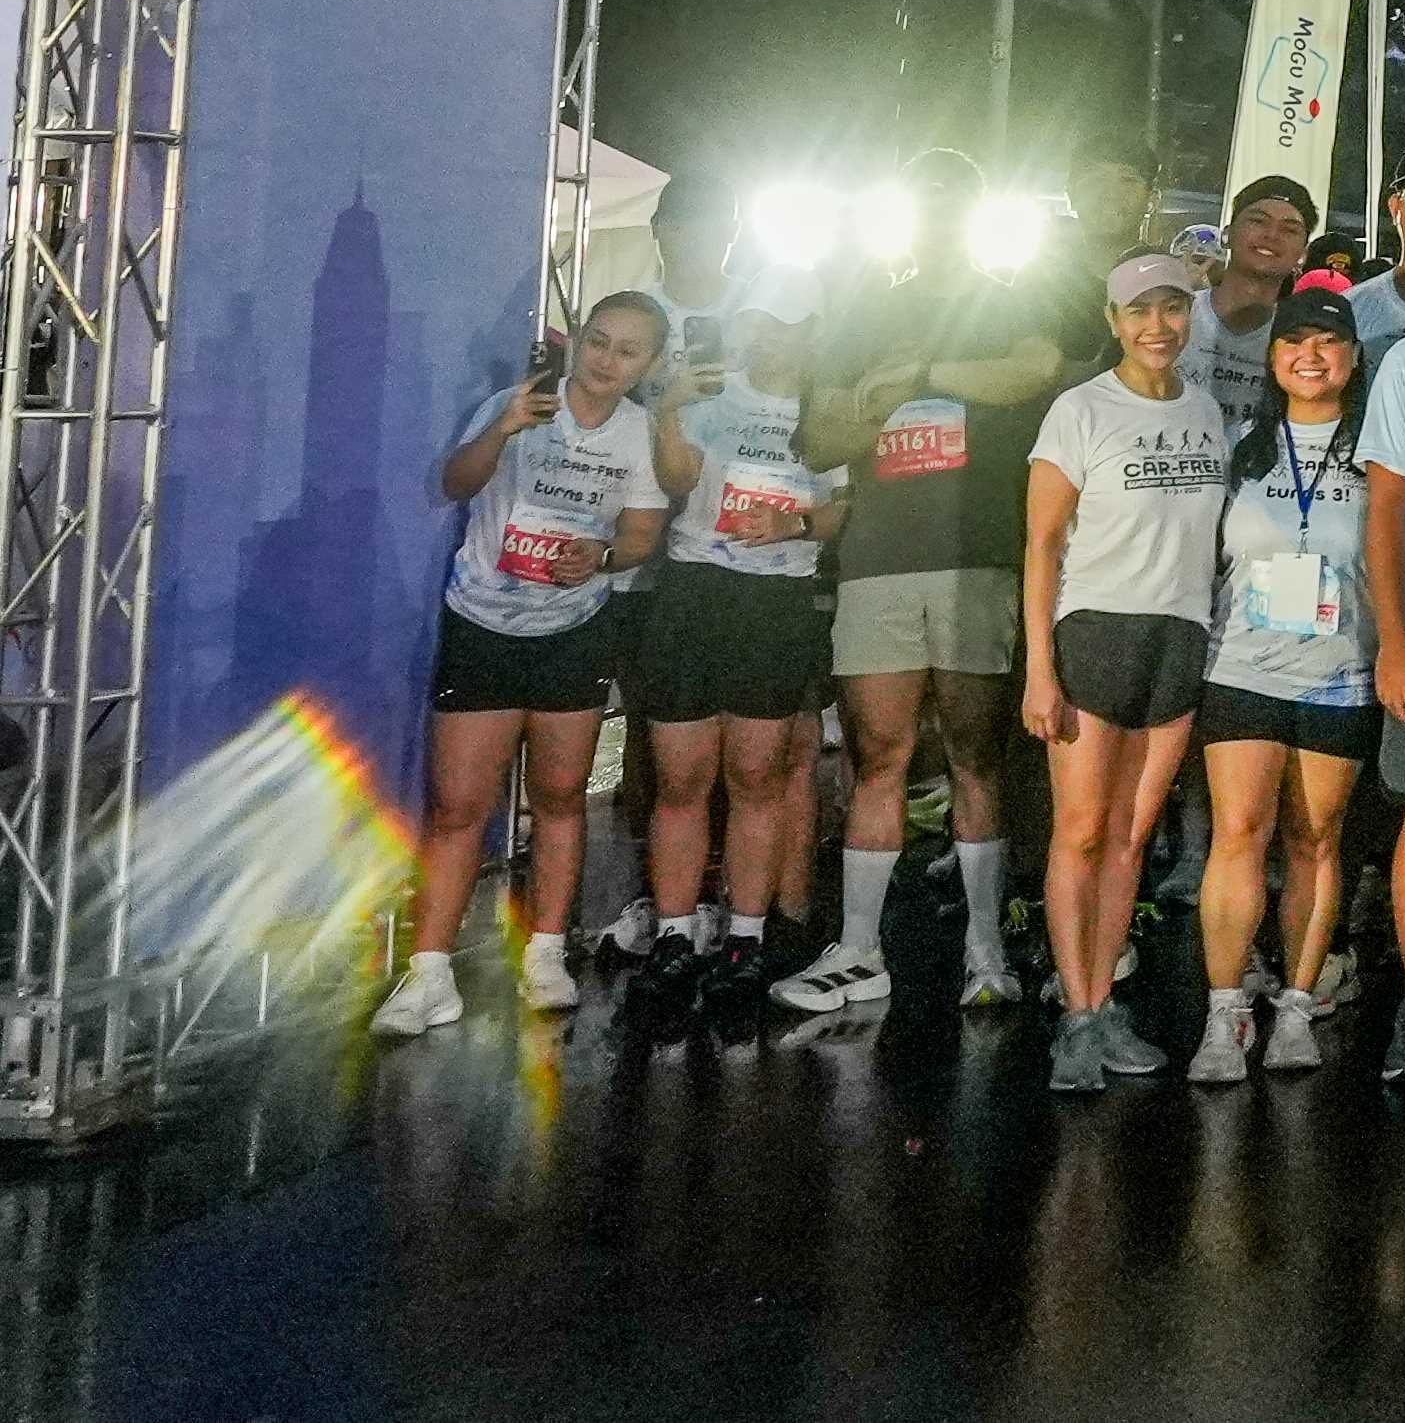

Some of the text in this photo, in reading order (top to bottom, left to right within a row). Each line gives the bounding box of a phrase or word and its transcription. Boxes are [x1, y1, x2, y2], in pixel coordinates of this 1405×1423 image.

[738, 443, 785, 462] turns
[1123, 458, 1222, 478] CAR-FREE
[534, 479, 585, 502] turns
[1333, 488, 1350, 502] 3!
[503, 533, 562, 561] 6066
